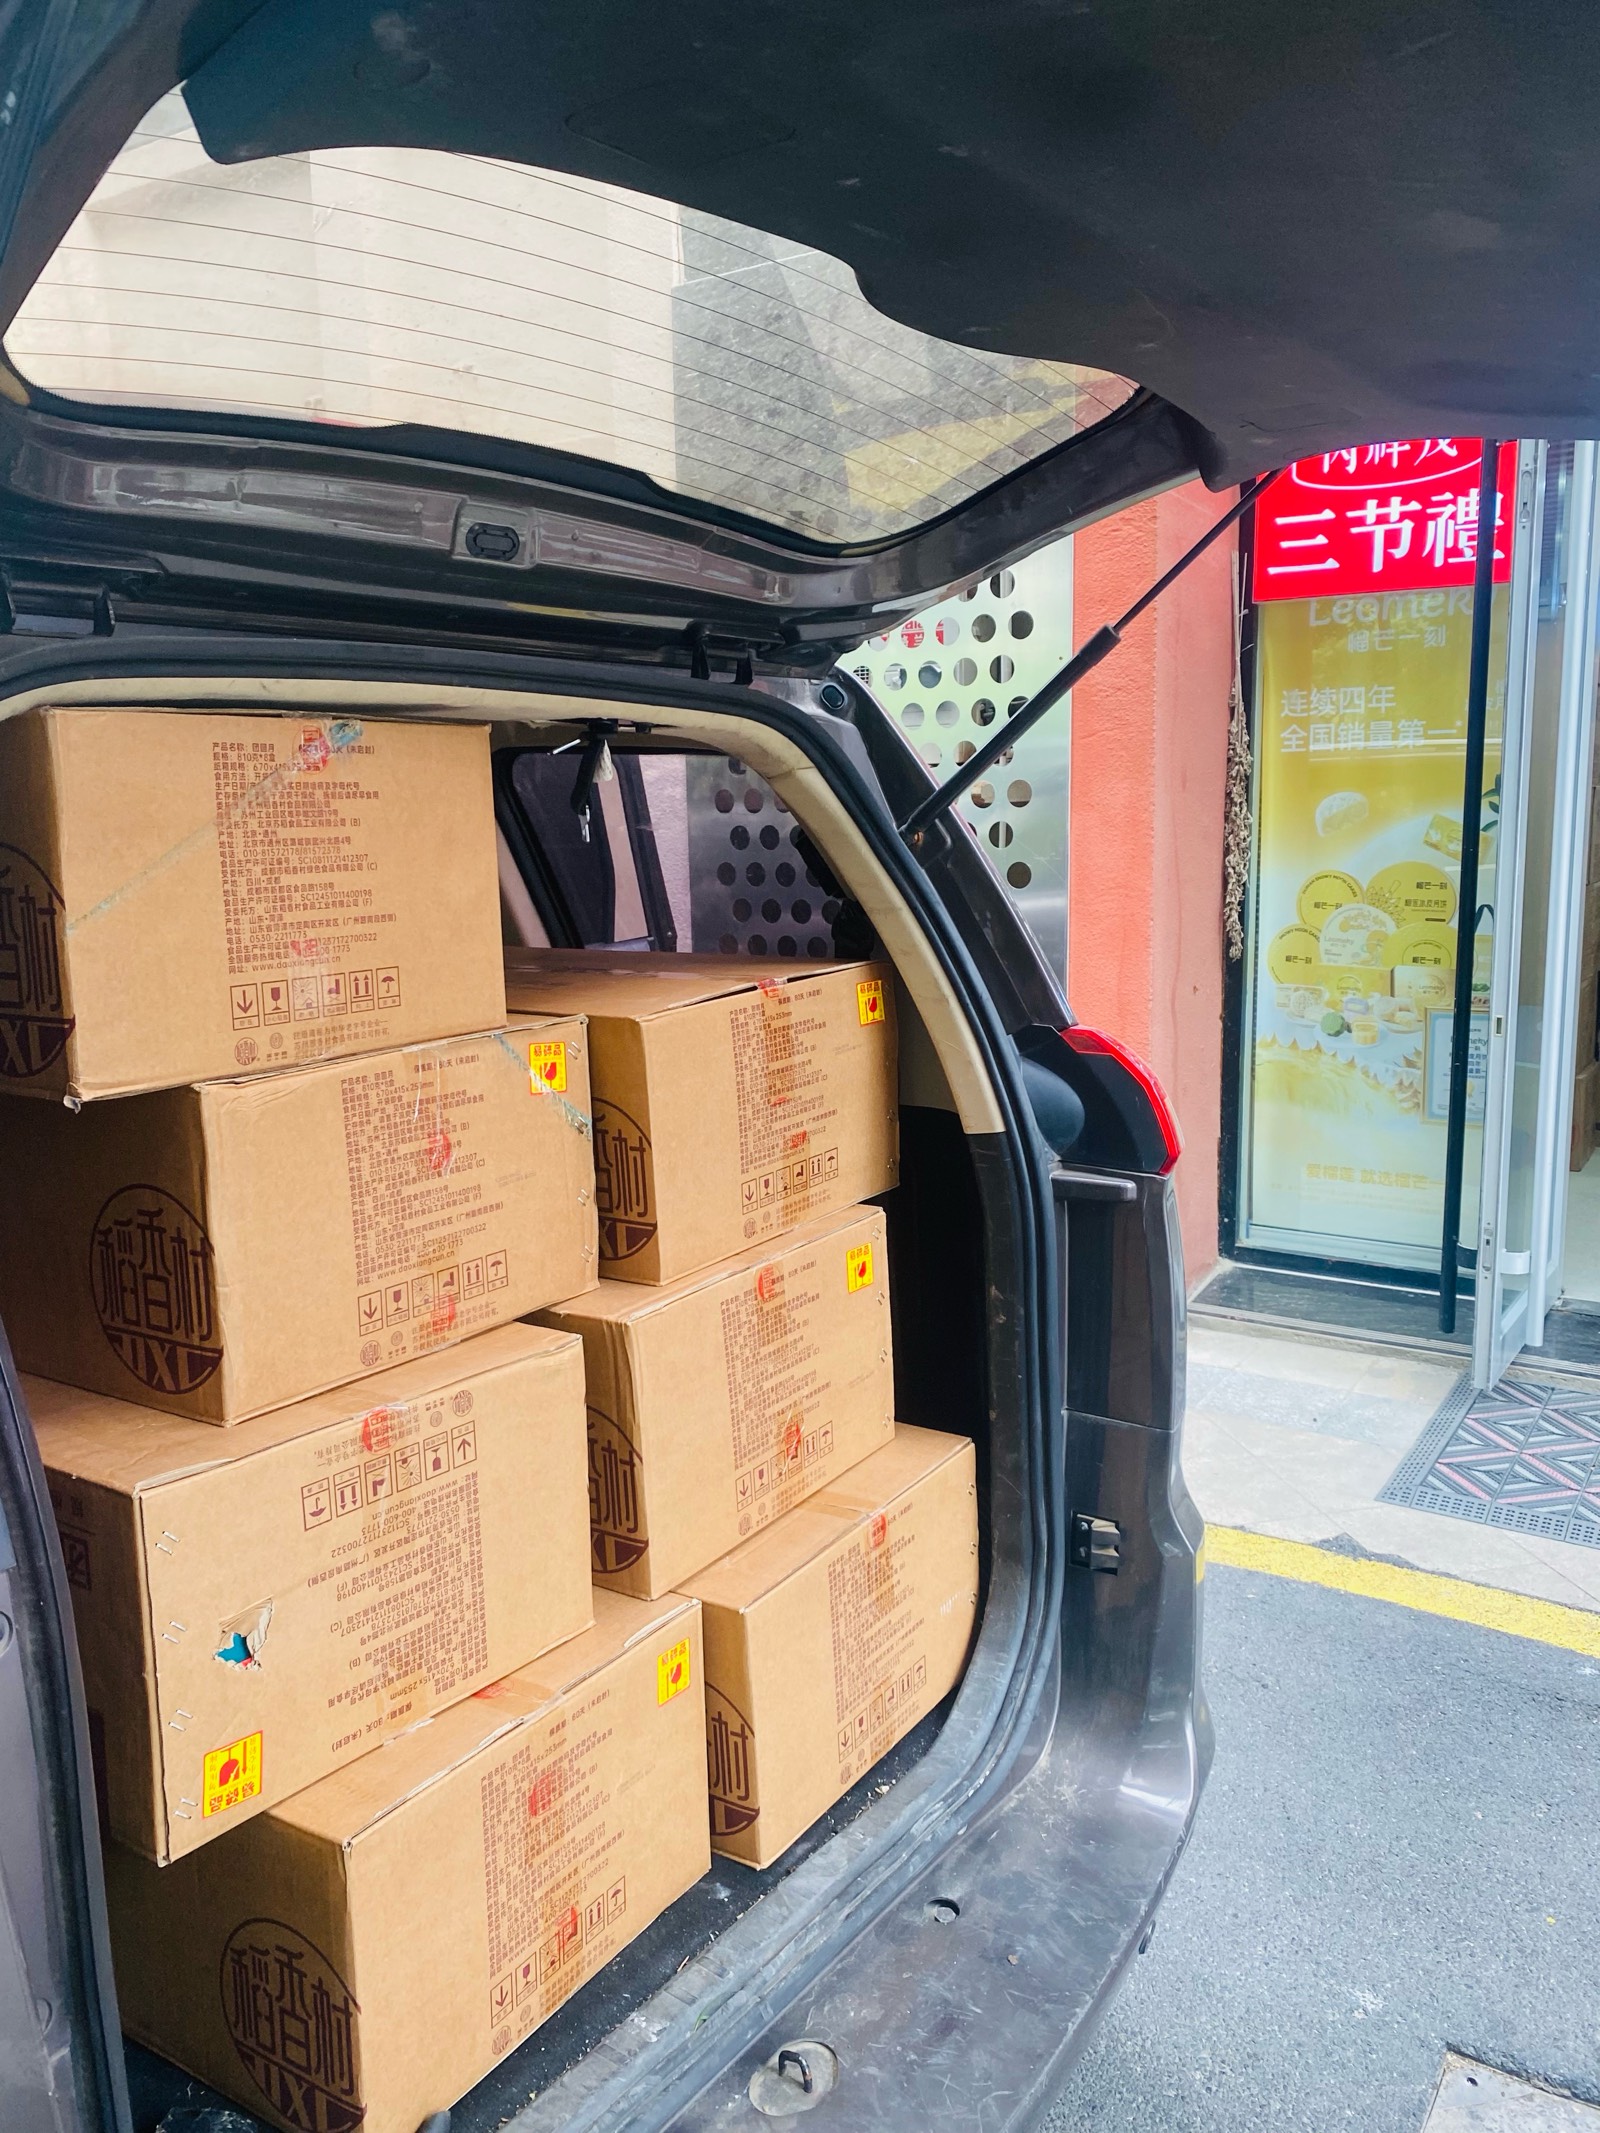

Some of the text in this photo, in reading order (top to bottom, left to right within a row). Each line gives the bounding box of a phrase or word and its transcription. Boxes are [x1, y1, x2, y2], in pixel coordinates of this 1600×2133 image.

[1280, 684, 1396, 718] 连续四年
[533, 1043, 562, 1057] 易碎品
[97, 1207, 212, 1342] 稻香村
[209, 1781, 255, 1812] 易碎品
[229, 1944, 354, 2095] 稻香村
